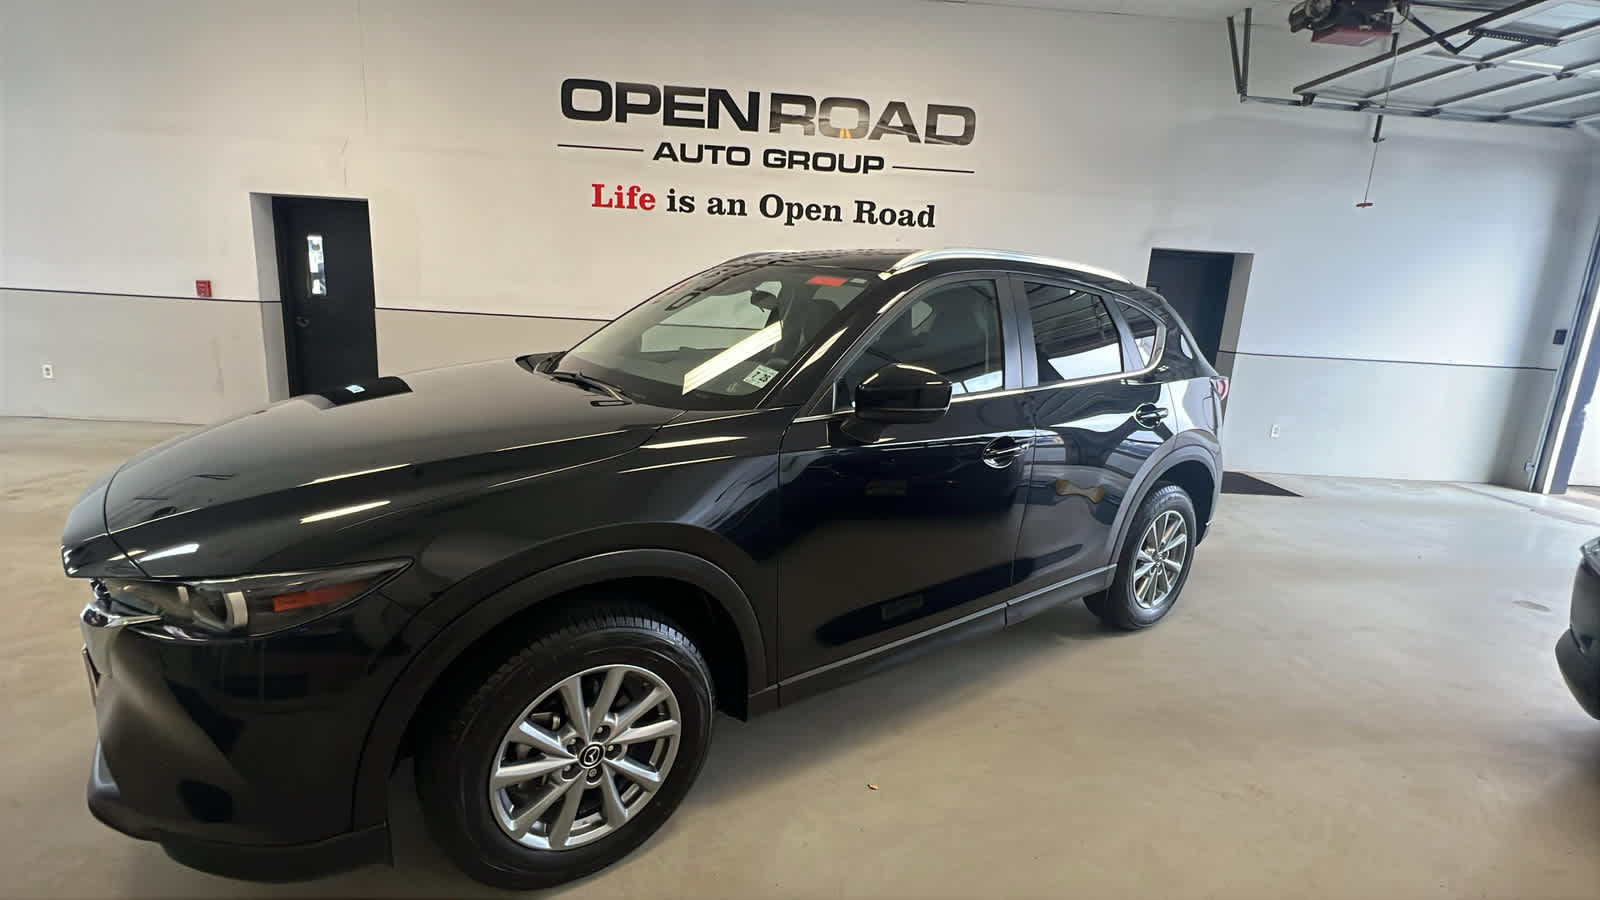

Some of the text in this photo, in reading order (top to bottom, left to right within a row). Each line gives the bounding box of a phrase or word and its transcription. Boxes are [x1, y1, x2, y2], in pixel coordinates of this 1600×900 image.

[561, 78, 977, 146] OPEN ROAD
[652, 141, 885, 174] AUTO GROUP
[591, 183, 936, 228] Life is an Open Road
